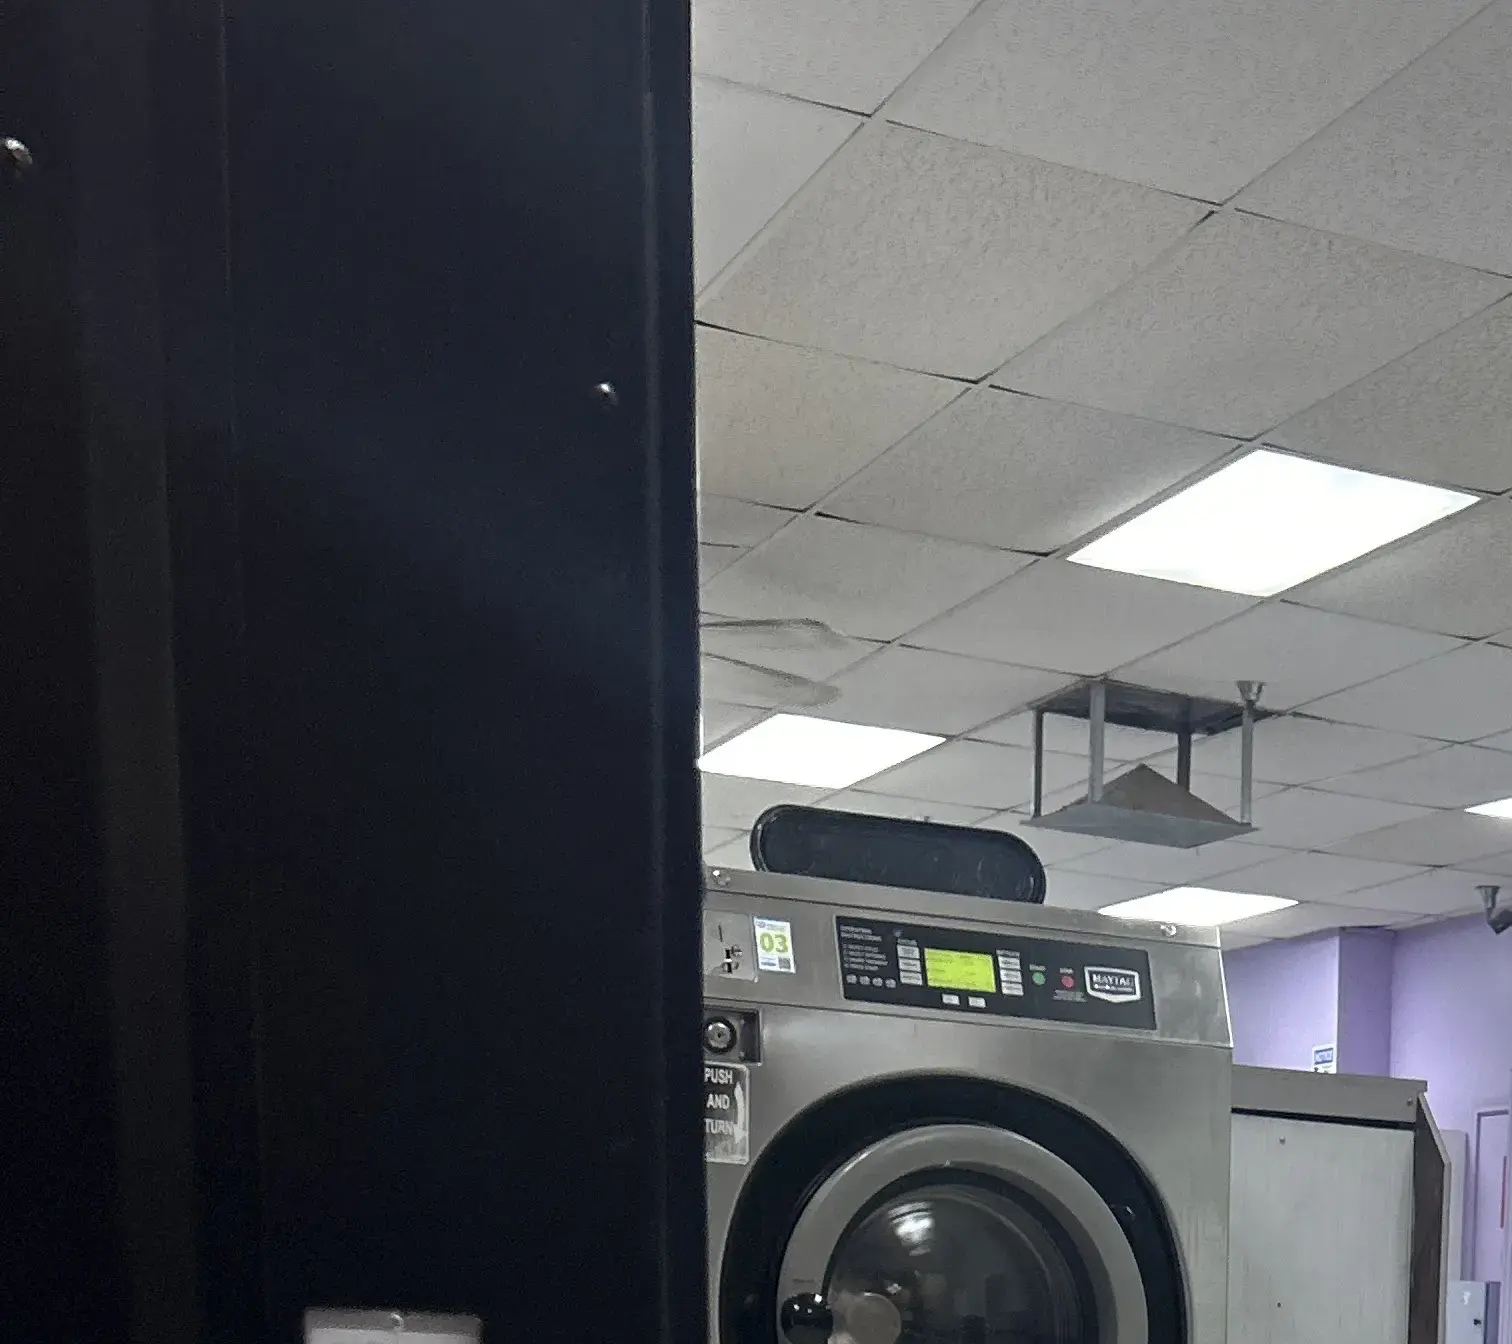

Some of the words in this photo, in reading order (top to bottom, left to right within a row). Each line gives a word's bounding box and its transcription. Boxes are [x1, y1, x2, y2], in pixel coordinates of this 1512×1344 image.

[760, 932, 789, 953] 03
[704, 1067, 733, 1084] PUSH
[706, 1093, 730, 1110] AND
[704, 1118, 735, 1136] TURN
